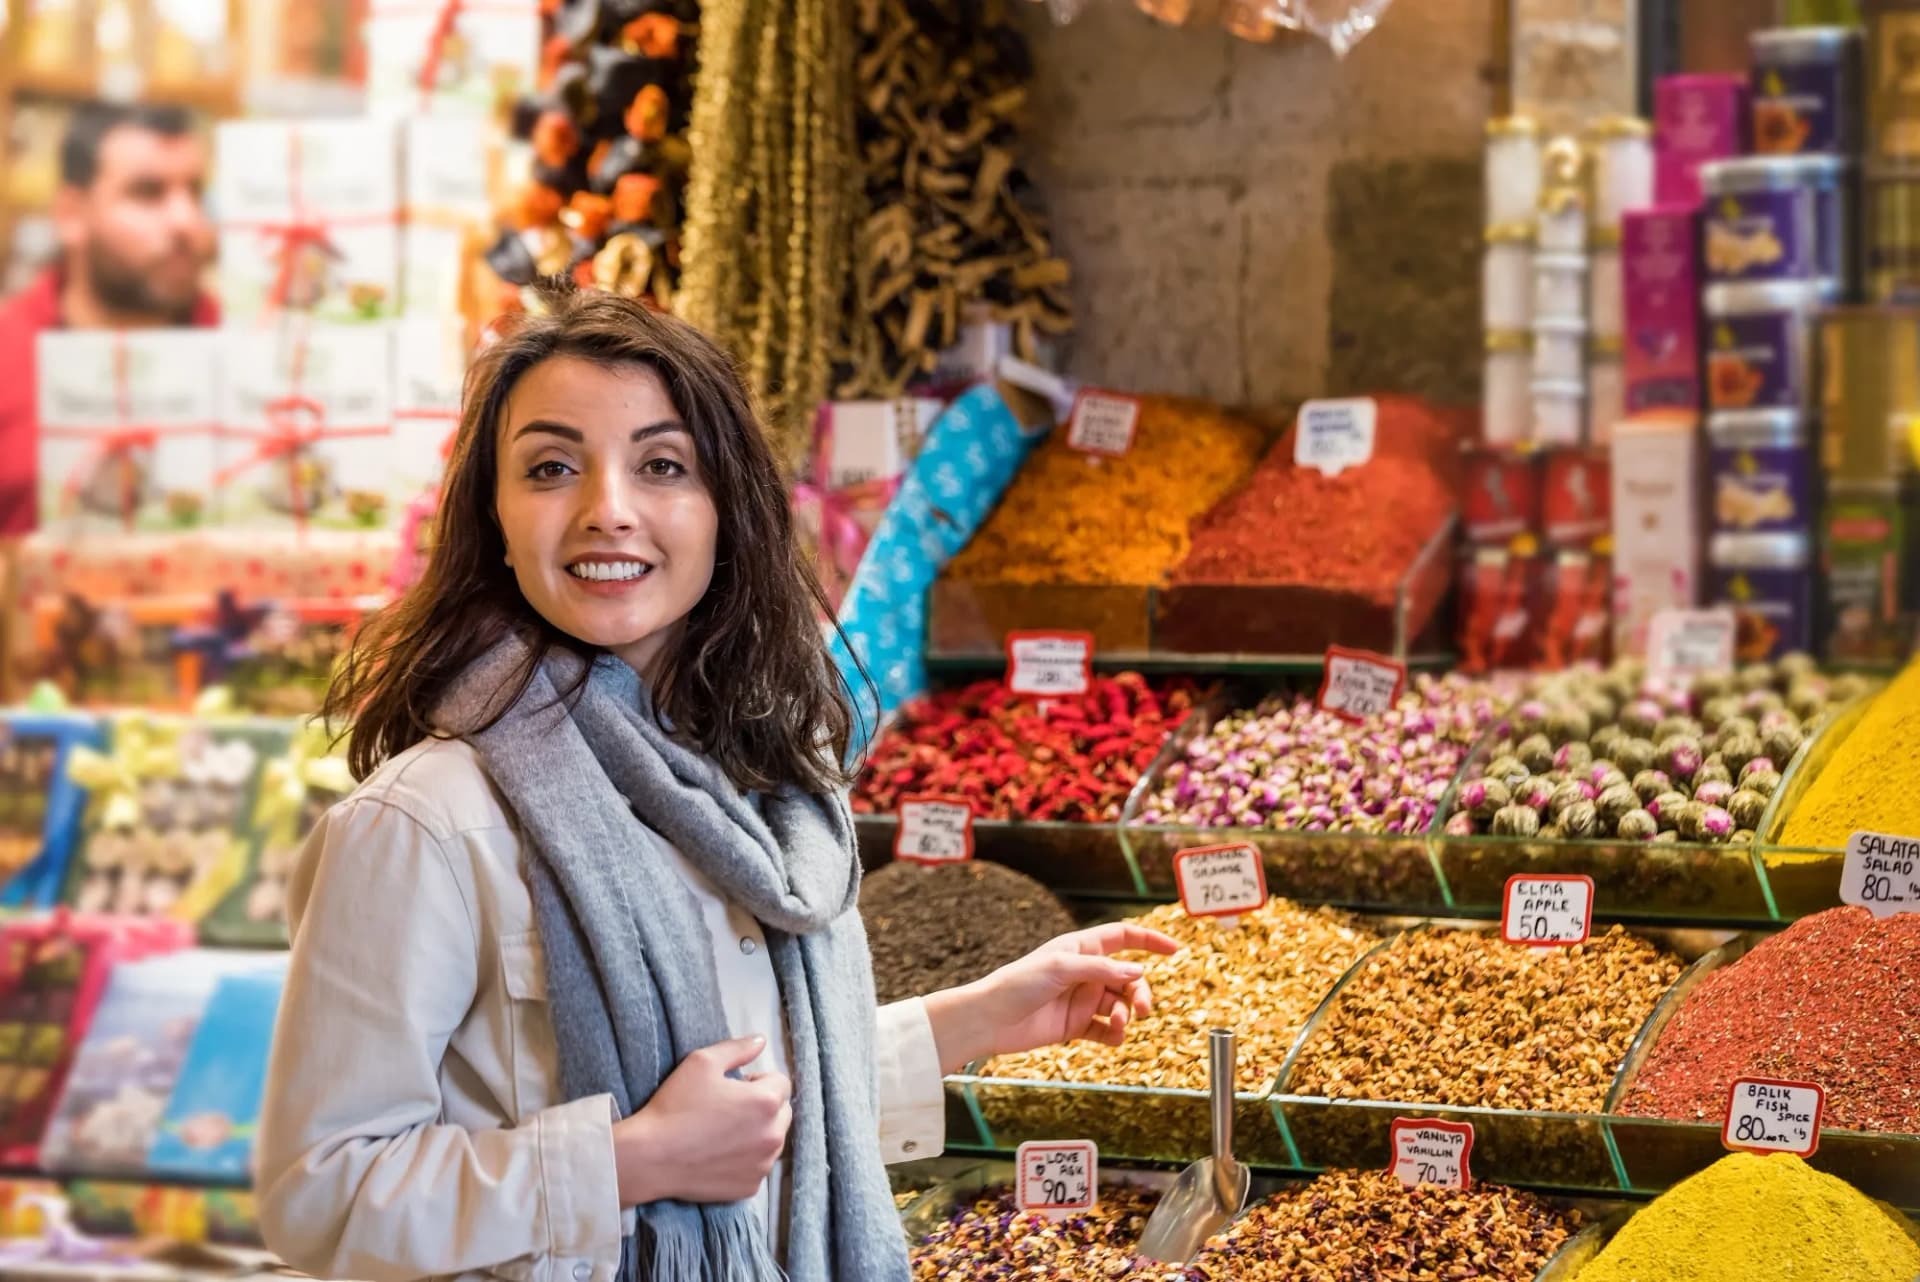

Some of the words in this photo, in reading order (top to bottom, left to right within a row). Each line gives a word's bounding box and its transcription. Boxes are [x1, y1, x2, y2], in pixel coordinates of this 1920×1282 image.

[1857, 835, 1920, 859] SALATA
[1863, 856, 1913, 875] SALAD
[1517, 882, 1563, 896] ELMA
[1523, 899, 1569, 912] APPLE
[1748, 1084, 1791, 1100] BALIK
[1755, 1099, 1789, 1112] FISH
[1777, 1112, 1810, 1122] SPICE
[1416, 1130, 1464, 1144] VANILYA
[1046, 1152, 1079, 1164] LOVE
